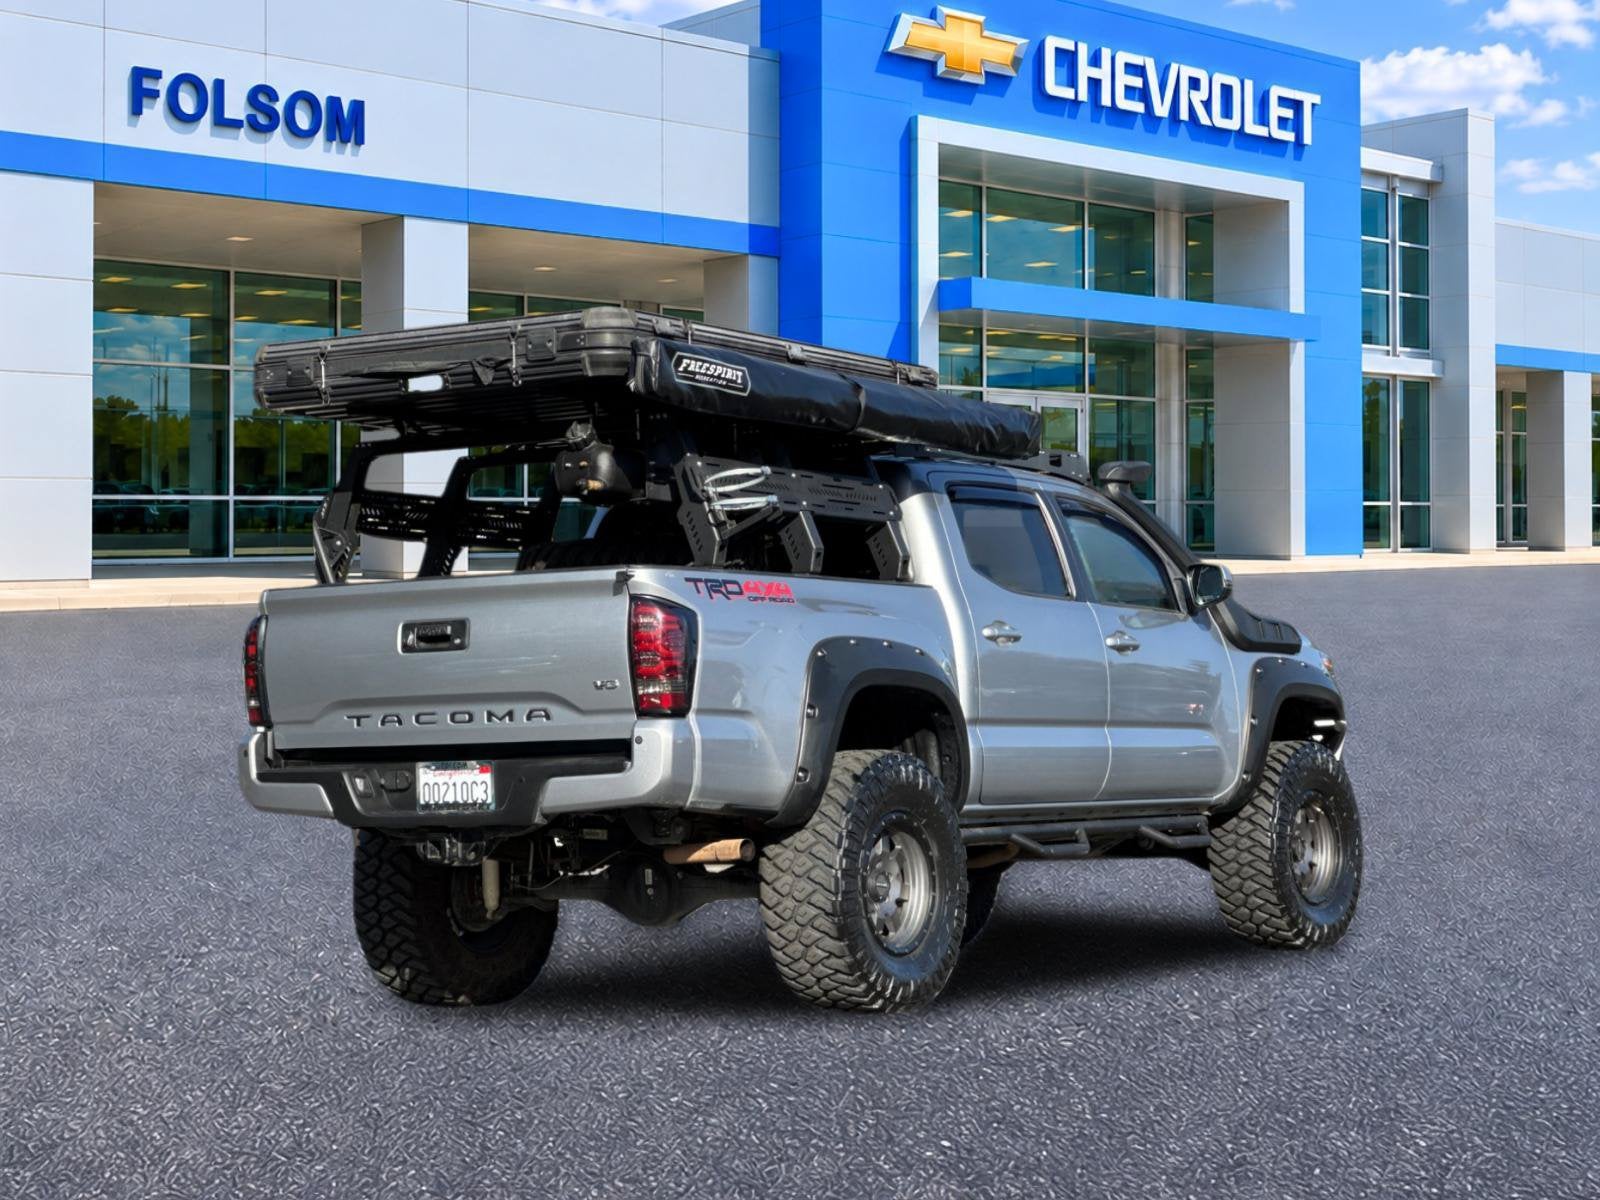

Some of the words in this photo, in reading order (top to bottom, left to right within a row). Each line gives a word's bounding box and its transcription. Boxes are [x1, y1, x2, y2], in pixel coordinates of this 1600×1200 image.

[1043, 35, 1321, 145] CHEVROLET
[130, 66, 365, 145] FOLSOM
[678, 359, 743, 383] FREESPIRIT
[684, 577, 744, 601] TRD
[768, 596, 795, 604] ROAD
[592, 679, 620, 691] V6
[345, 707, 553, 729] TACOMA
